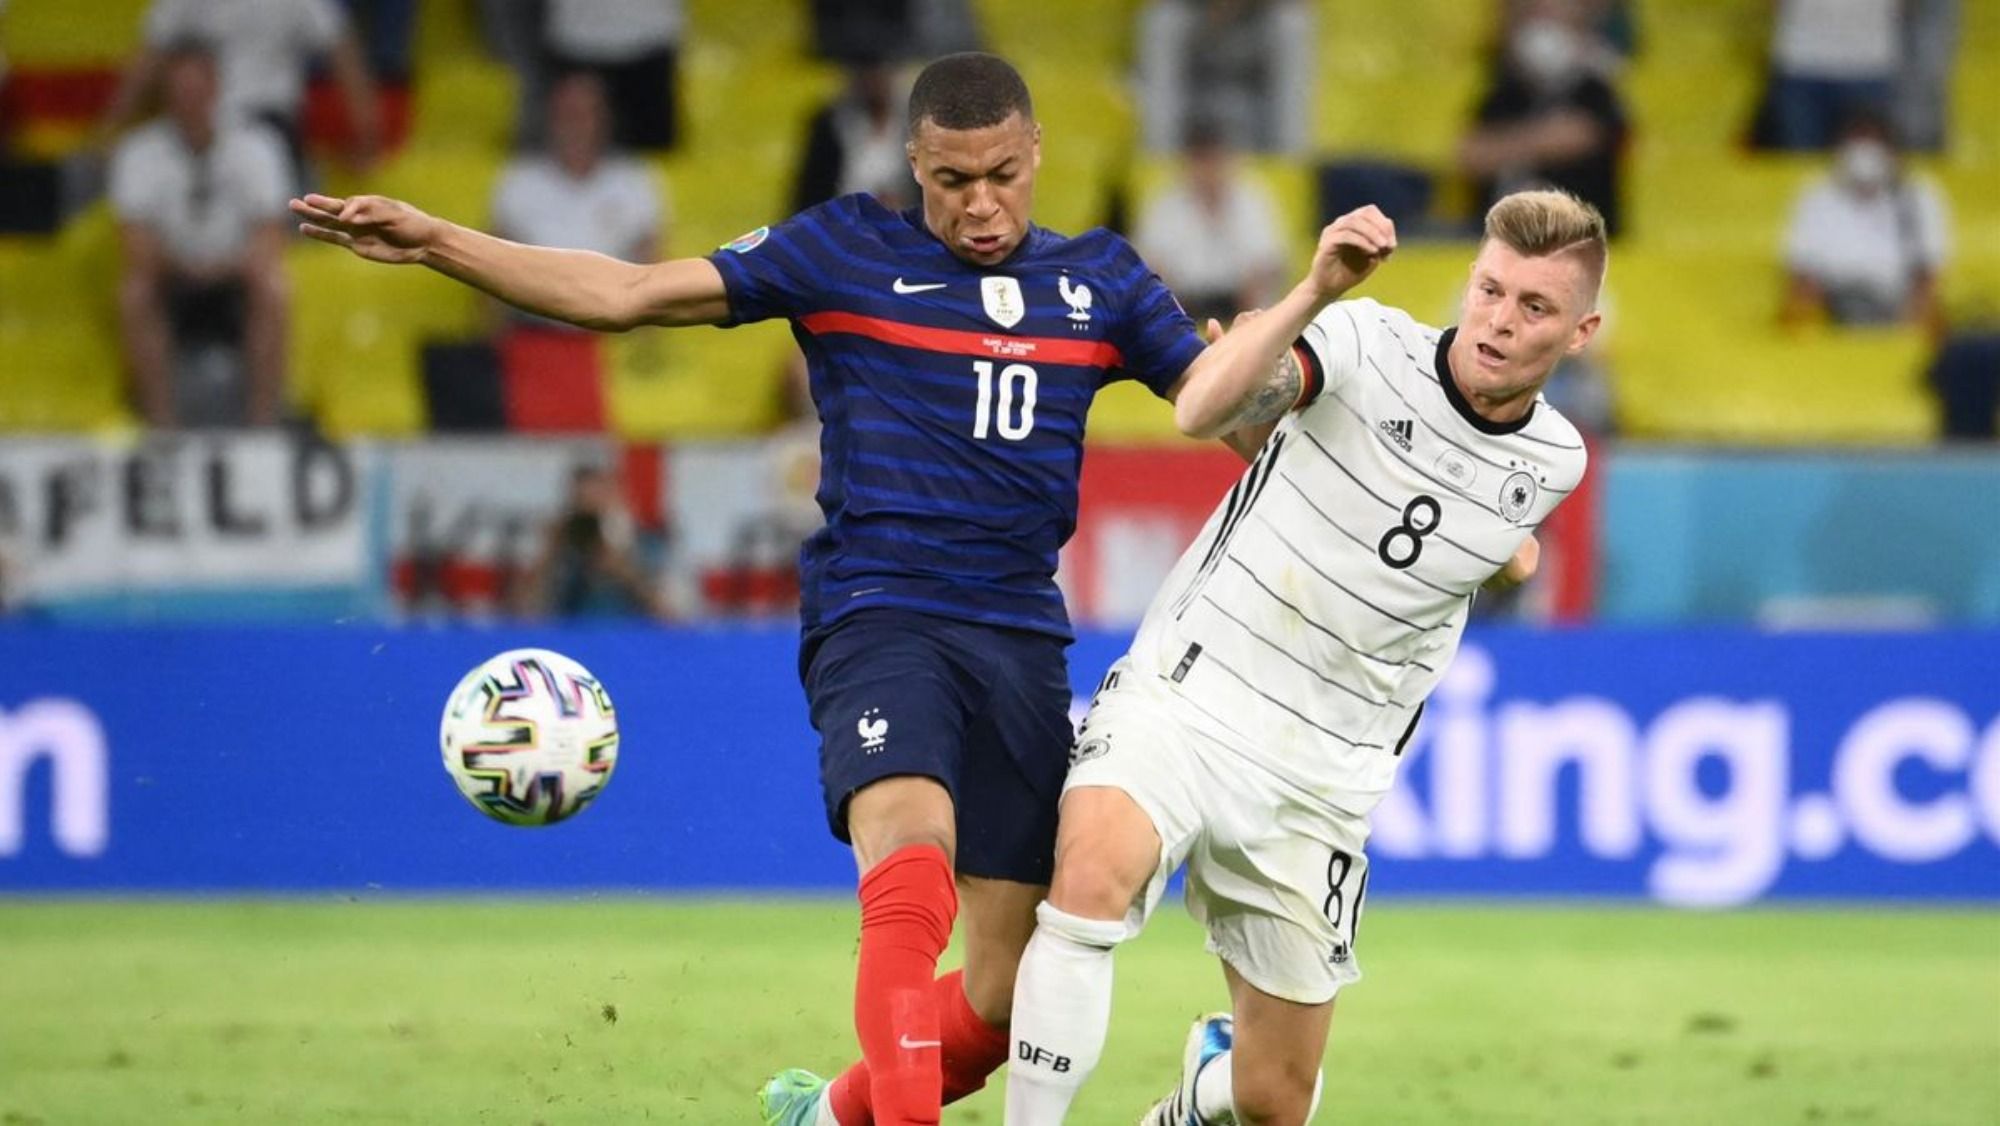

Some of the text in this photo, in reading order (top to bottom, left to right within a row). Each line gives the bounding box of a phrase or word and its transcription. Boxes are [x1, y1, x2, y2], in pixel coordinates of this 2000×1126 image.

[973, 361, 1038, 440] 10
[1380, 421, 1413, 453] adidas
[0, 444, 357, 546] FELD
[1378, 494, 1442, 570] 8
[1323, 849, 1352, 930] 8
[1019, 1040, 1071, 1073] DFB
